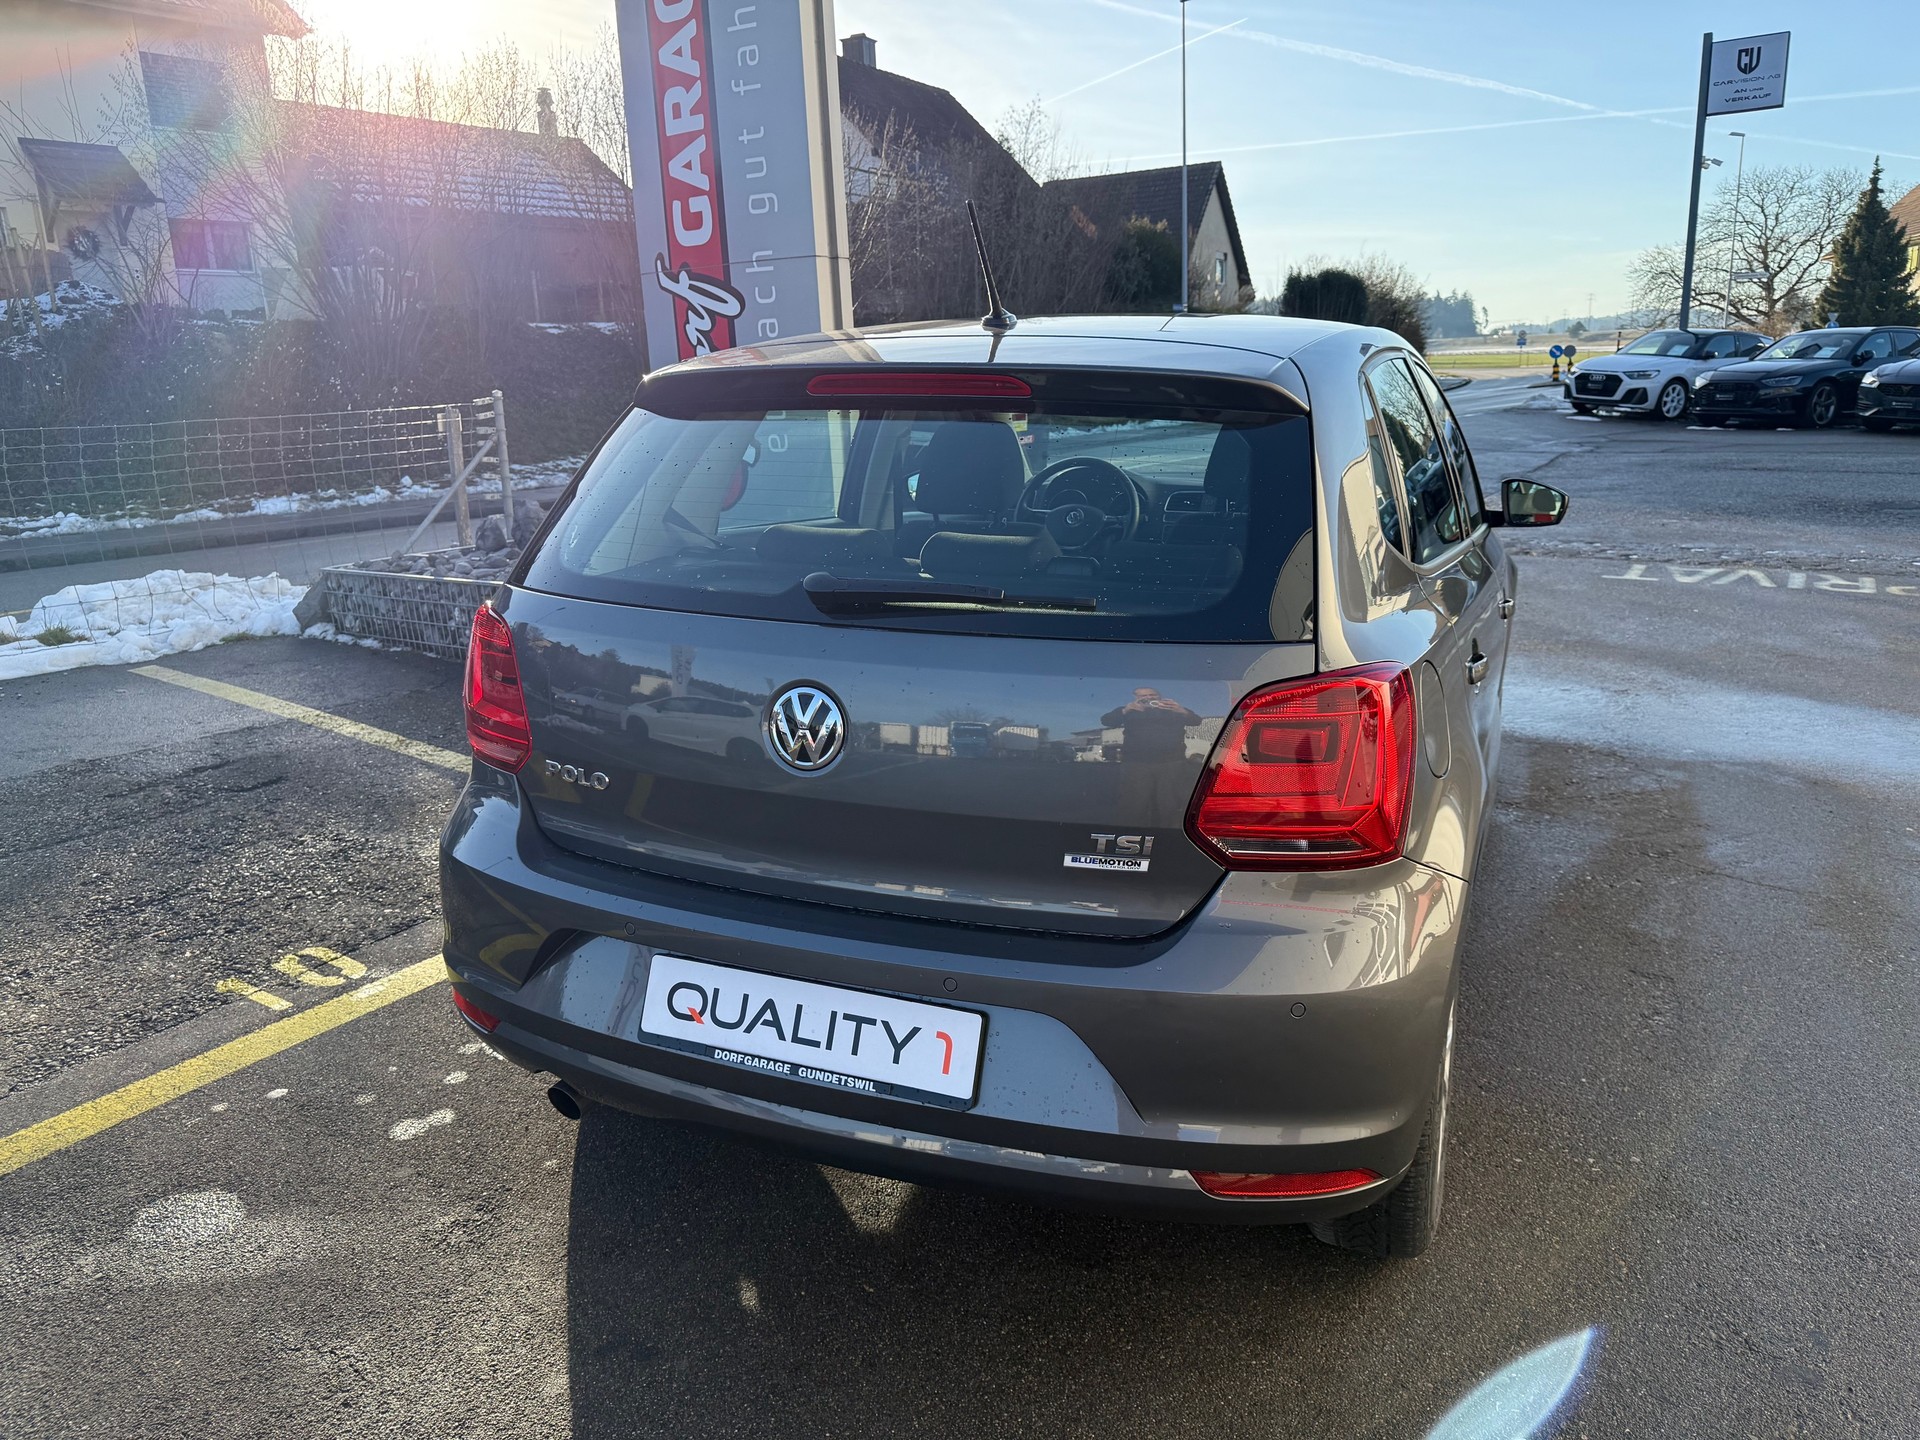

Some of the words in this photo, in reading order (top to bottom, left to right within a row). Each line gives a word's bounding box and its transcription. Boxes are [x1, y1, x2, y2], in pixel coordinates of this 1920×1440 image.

[727, 5, 761, 96] fah
[1713, 75, 1765, 87] CARVISION
[1724, 93, 1772, 103] VERKAUF
[738, 125, 778, 215] gut
[545, 759, 610, 790] POLO
[1071, 856, 1141, 867] BLUEMOTION
[1090, 833, 1154, 855] TSI
[214, 946, 368, 1011] 10
[667, 981, 923, 1065] QUALITY
[935, 1030, 953, 1075] 1
[714, 1049, 790, 1074] DORFGARAGE
[798, 1067, 876, 1092] GUNDETSWIL
